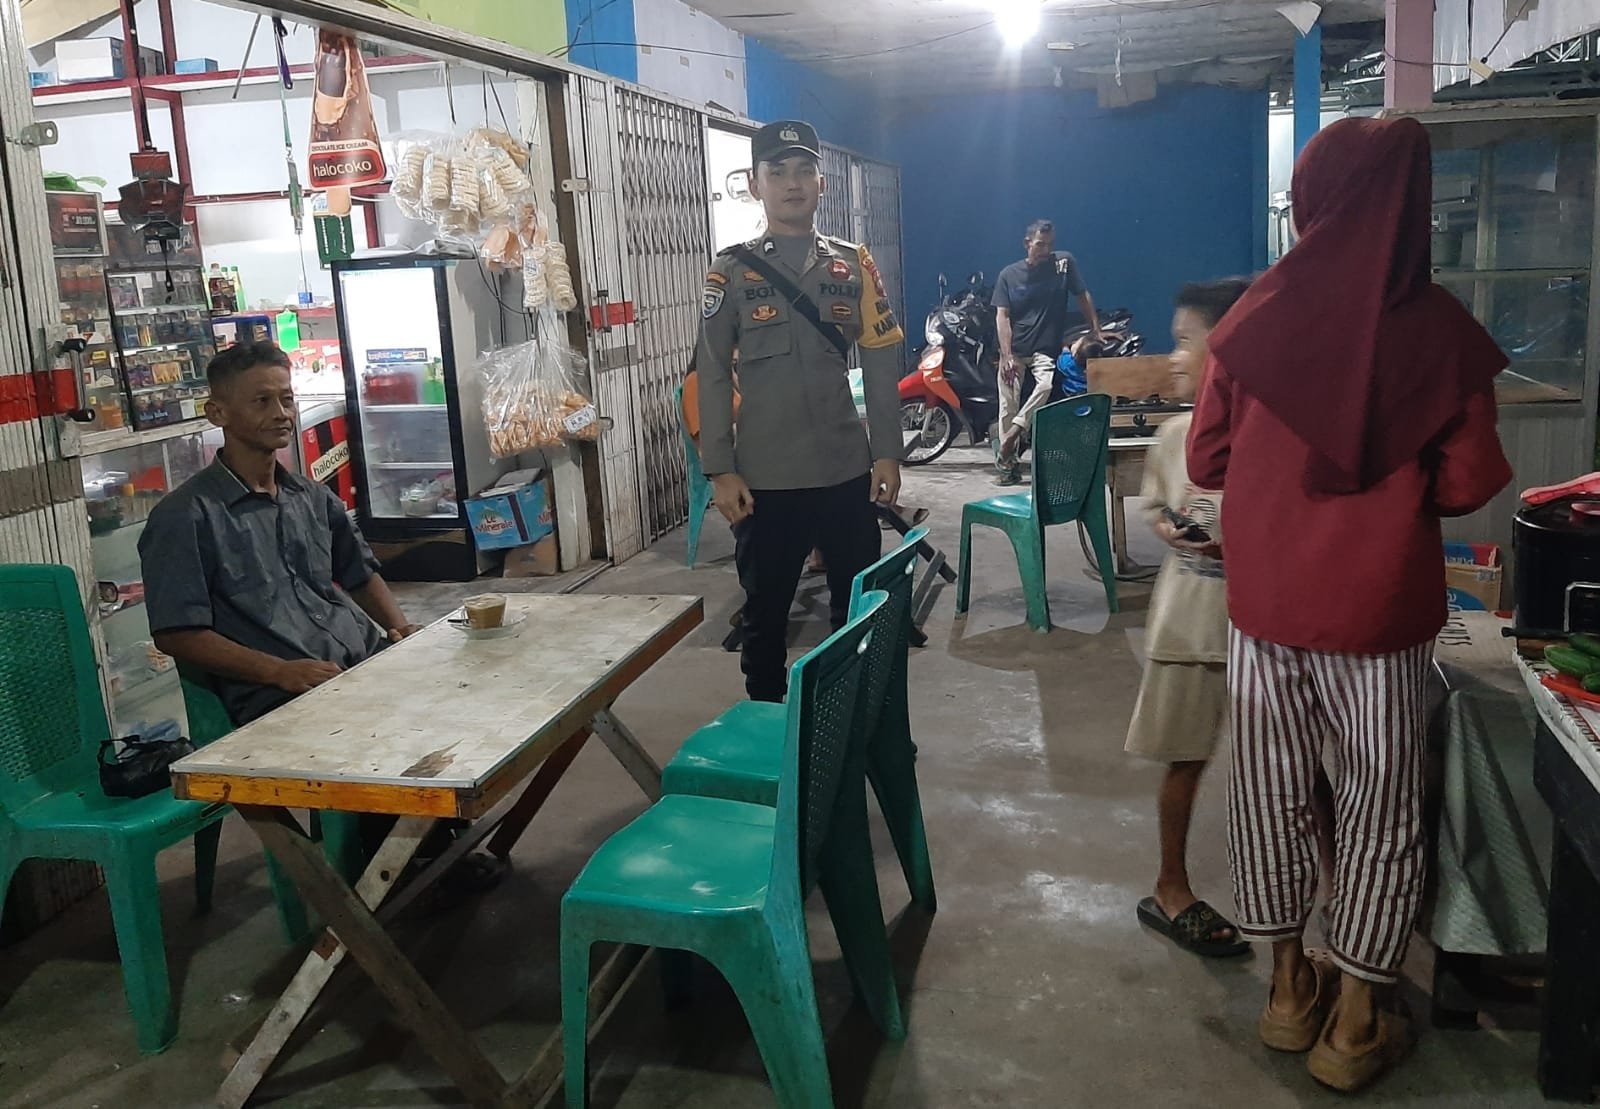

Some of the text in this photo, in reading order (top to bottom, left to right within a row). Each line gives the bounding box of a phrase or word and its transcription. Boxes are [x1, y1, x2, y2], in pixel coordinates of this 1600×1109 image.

[312, 159, 372, 178] halocoko
[313, 446, 349, 478] halocoko
[475, 519, 513, 532] Minerale
